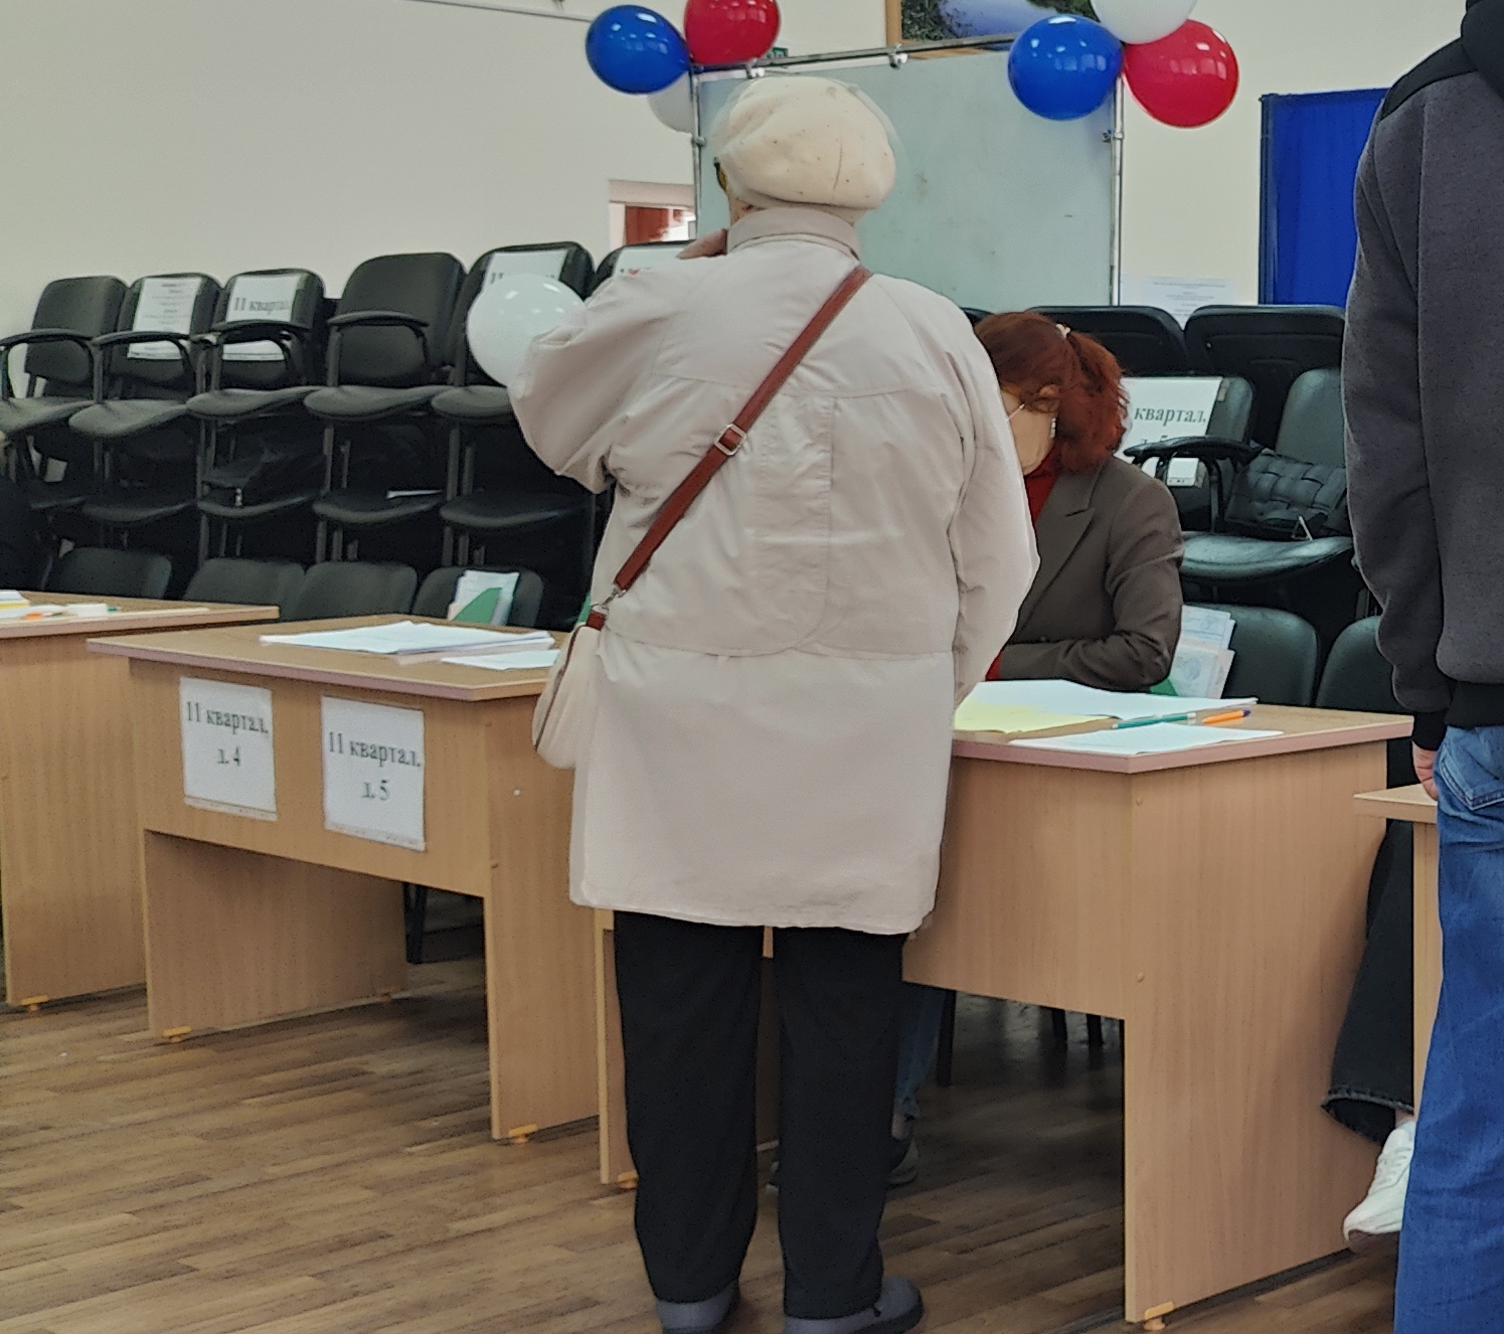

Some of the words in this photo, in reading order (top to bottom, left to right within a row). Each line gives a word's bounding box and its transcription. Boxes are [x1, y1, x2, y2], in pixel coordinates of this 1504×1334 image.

[187, 701, 201, 723] 11
[329, 731, 344, 754] 11
[380, 779, 391, 801] 5
